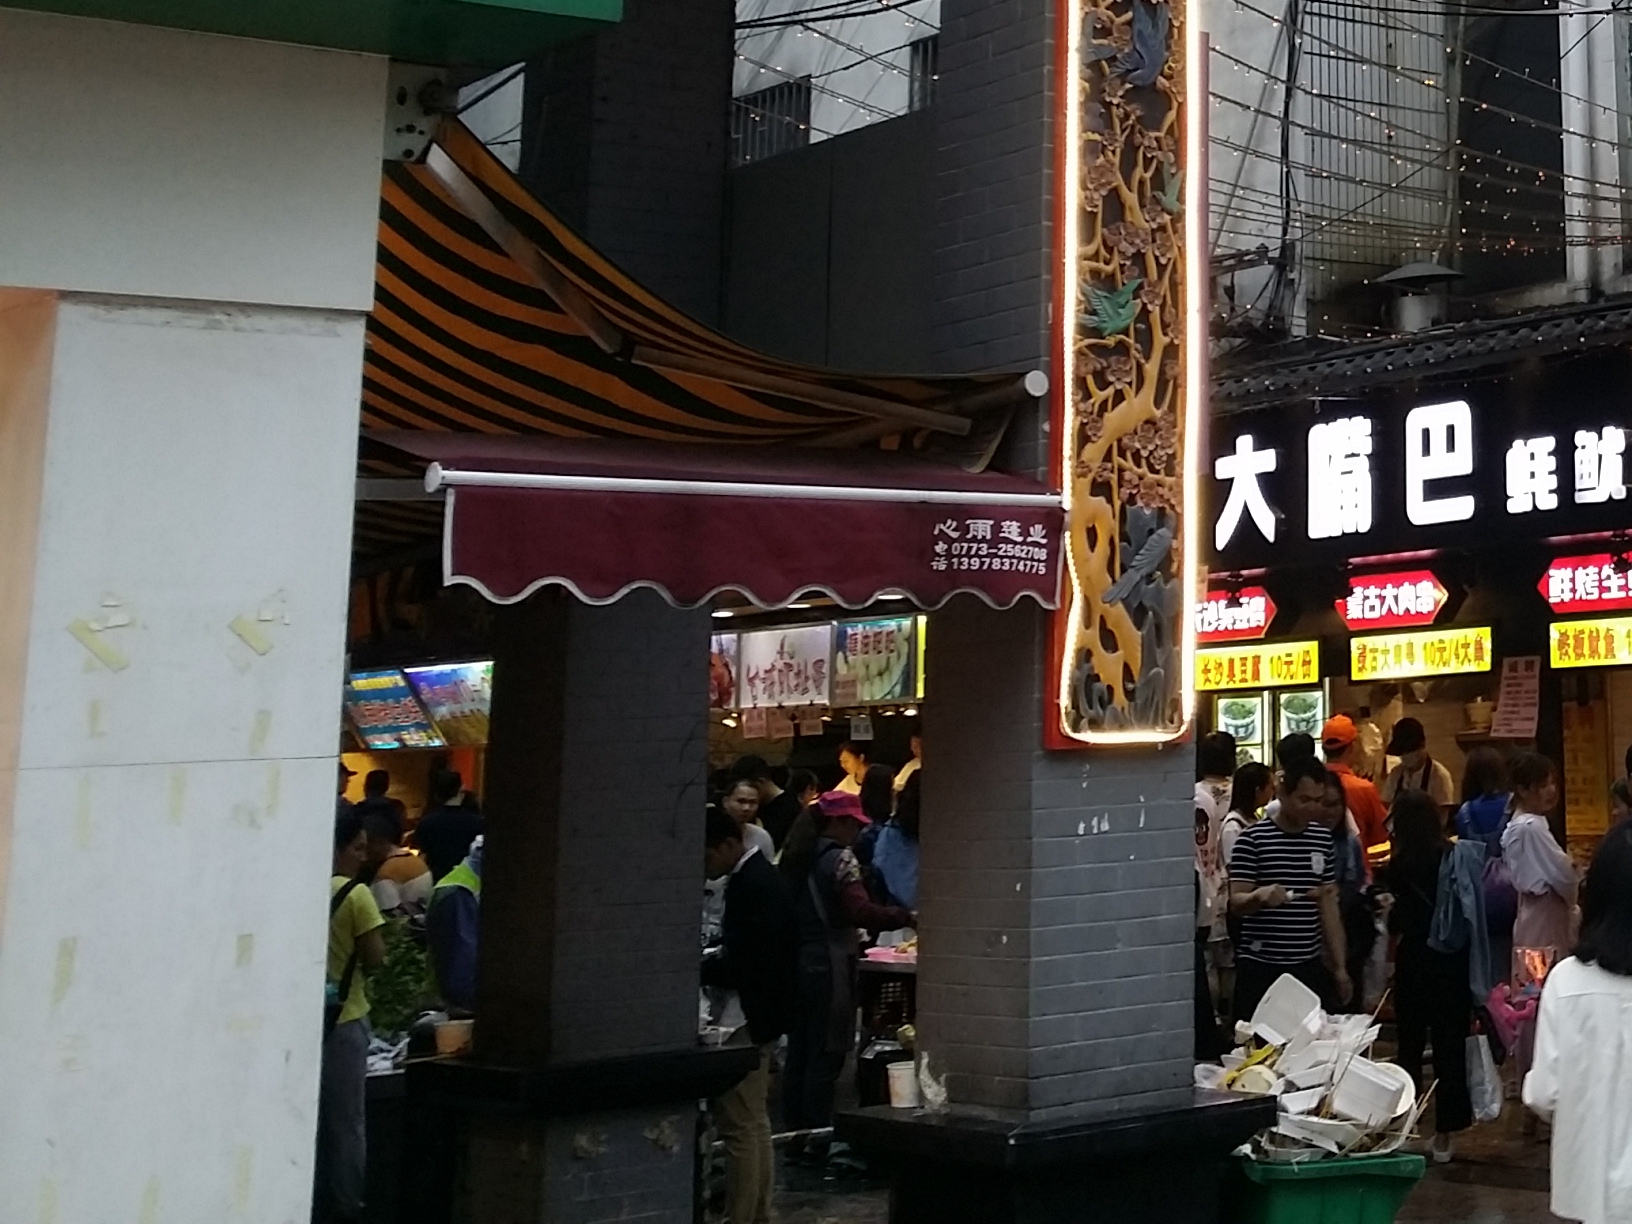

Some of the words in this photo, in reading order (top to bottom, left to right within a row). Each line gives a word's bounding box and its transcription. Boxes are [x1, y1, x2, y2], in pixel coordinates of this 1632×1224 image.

[1214, 400, 1476, 551] 大嘴巴
[951, 557, 1047, 575] 13978374775
[1346, 580, 1436, 619] 蒙古大肉串
[1557, 627, 1617, 661] 铁板鱿鱼
[1201, 654, 1262, 686] 长沙臭豆腐
[1269, 649, 1312, 681] 10元/份
